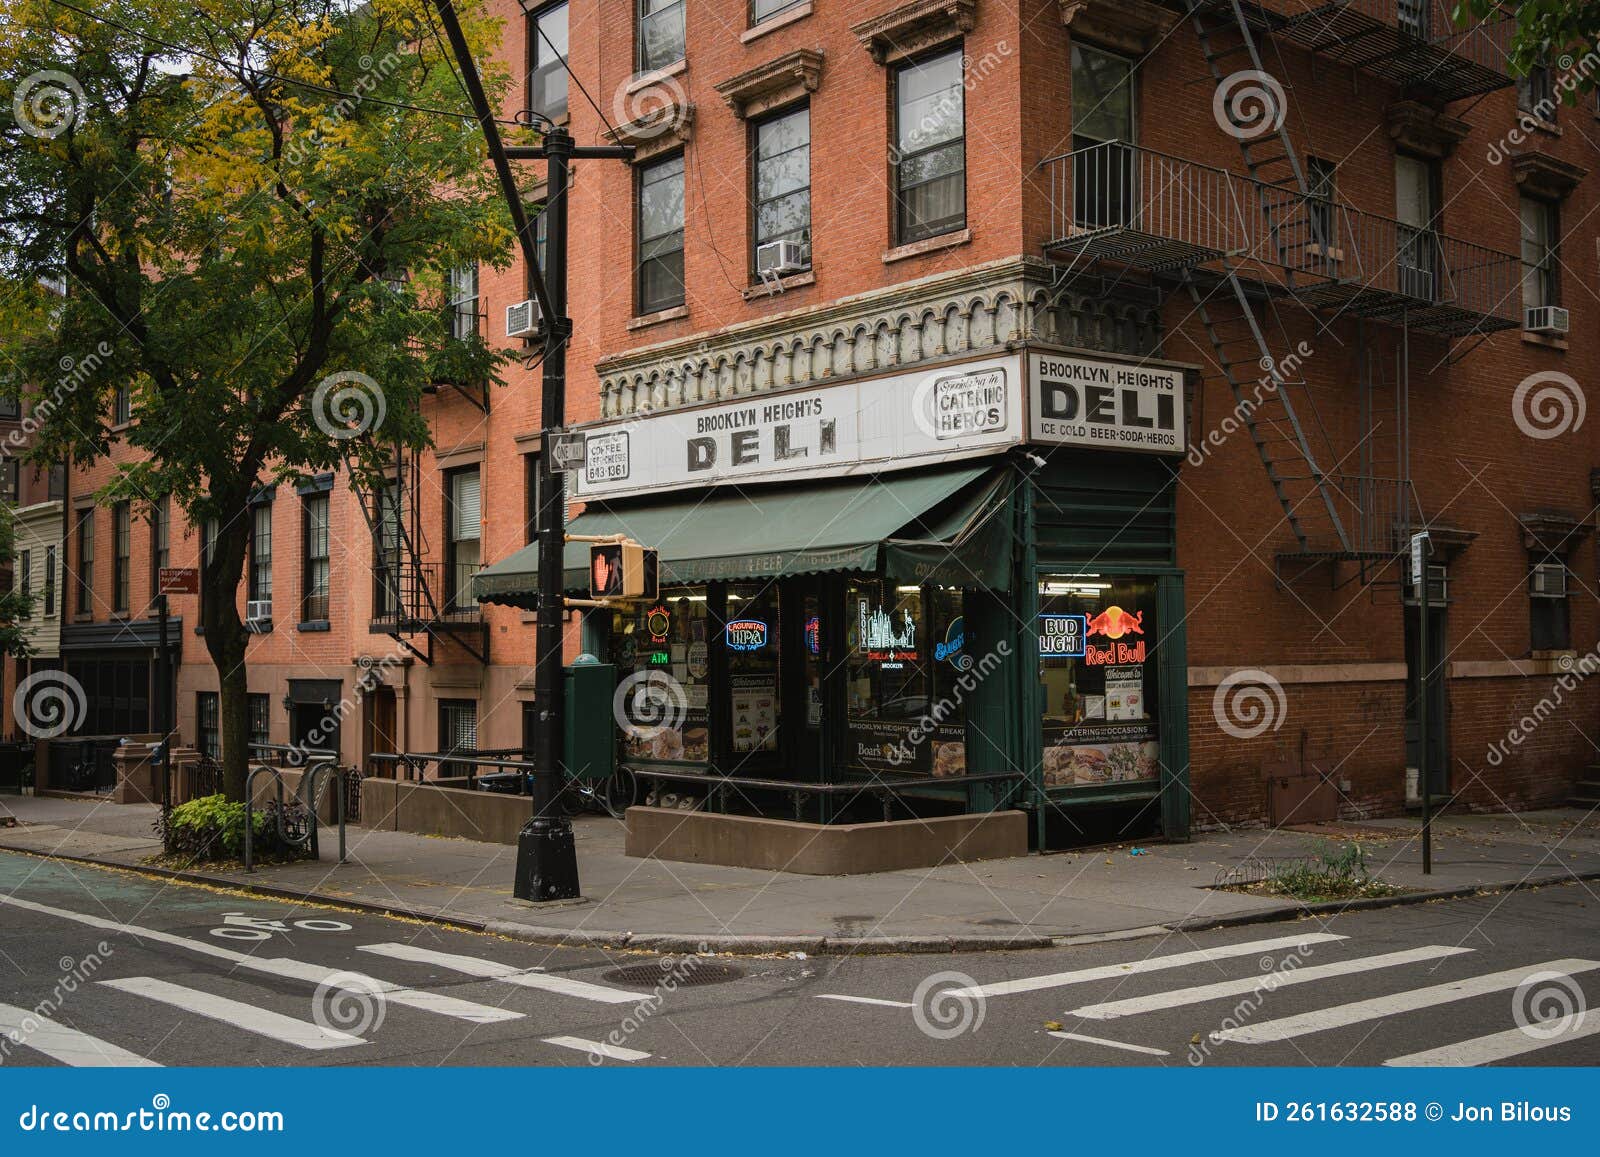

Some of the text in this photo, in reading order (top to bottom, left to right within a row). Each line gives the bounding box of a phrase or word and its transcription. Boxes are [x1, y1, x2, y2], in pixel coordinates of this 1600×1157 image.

[1040, 361, 1174, 390] BROOKLYN HEIGHTS
[940, 386, 1003, 411] CATERING
[1040, 380, 1175, 430] DELI
[697, 398, 823, 434] BROOKLYN HEIGHTS
[942, 408, 1000, 431] HEROS
[1041, 423, 1056, 435] ICE
[1059, 425, 1086, 437] COLD
[591, 443, 622, 456] COFFEE
[687, 417, 837, 472] DELI
[728, 622, 765, 632] LAGUNITAS
[1045, 618, 1078, 636] BUD
[732, 630, 763, 645] IPA
[1039, 635, 1083, 653] LIGHT
[651, 653, 669, 664] ATM
[1085, 640, 1146, 666] Red Bull
[1063, 728, 1101, 737] CATERING
[1107, 726, 1148, 735] OCCASIONS
